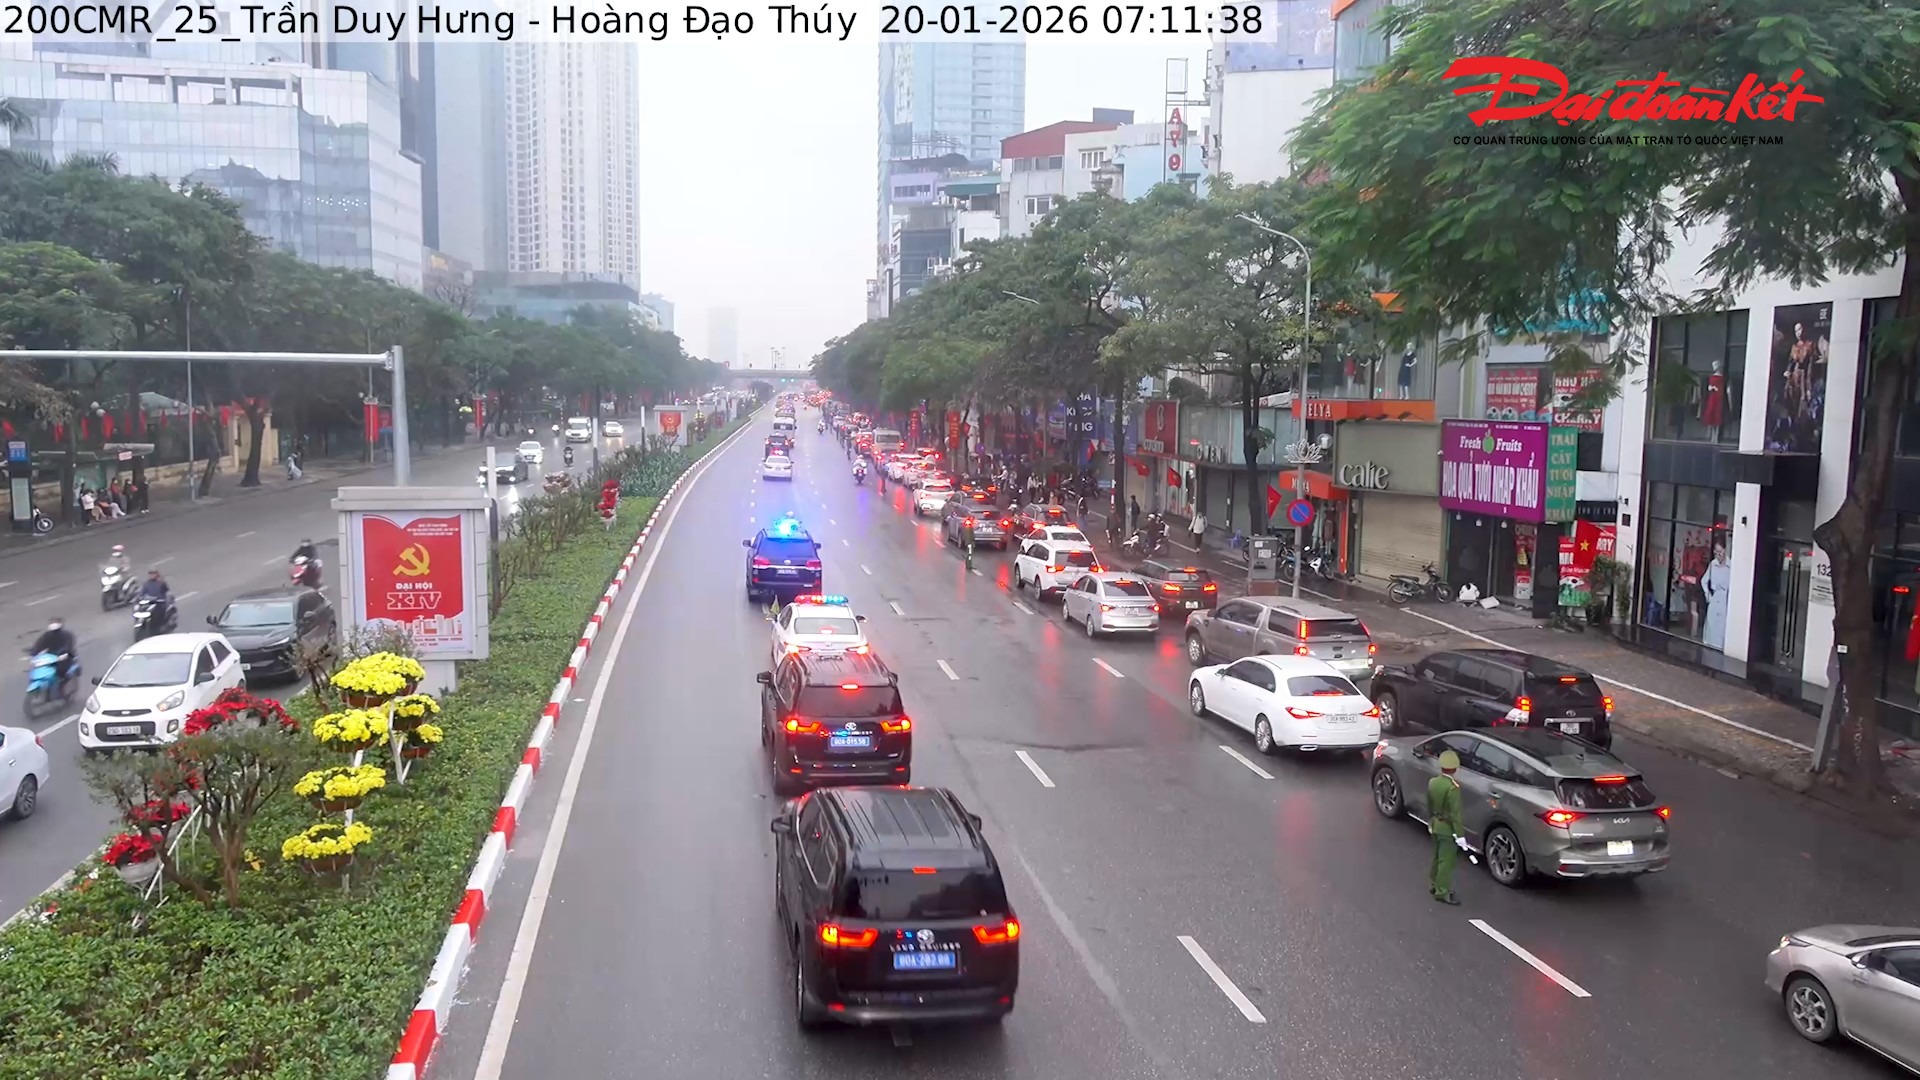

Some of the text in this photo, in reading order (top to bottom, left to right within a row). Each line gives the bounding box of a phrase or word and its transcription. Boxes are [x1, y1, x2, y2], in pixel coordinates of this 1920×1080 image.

[1459, 435, 1523, 452] Fresh Fruits
[1442, 460, 1457, 498] HOA
[1457, 450, 1474, 504] QUẢ
[1492, 457, 1515, 515] NHẬP
[395, 580, 433, 592] ĐẠI HỘI
[387, 591, 442, 611] XIV
